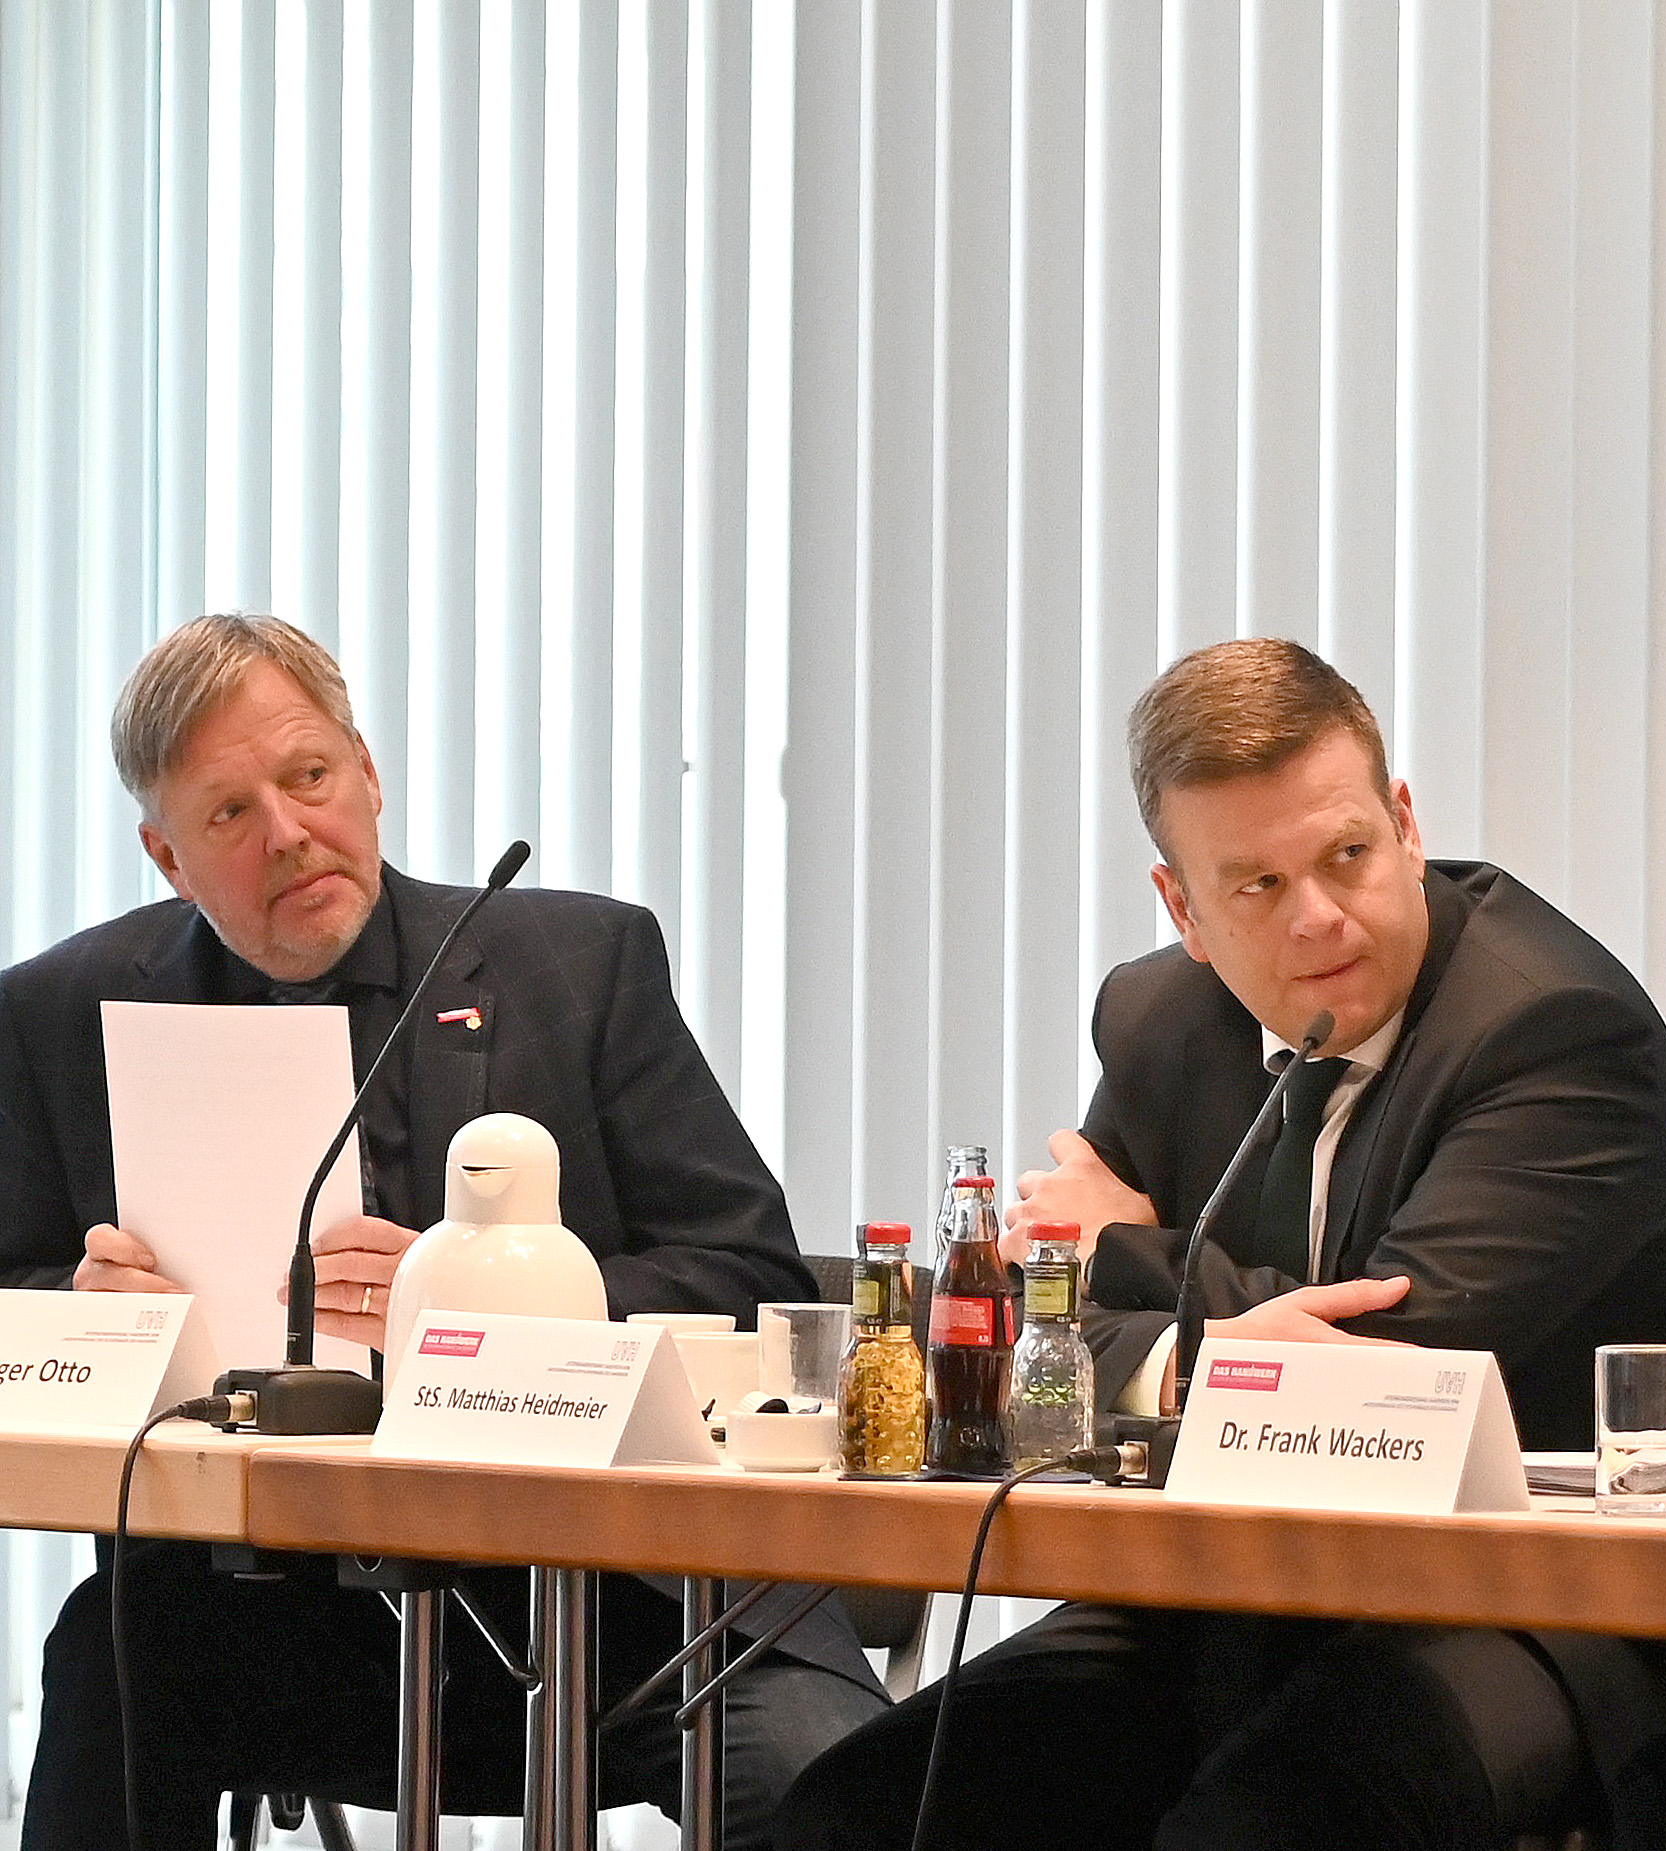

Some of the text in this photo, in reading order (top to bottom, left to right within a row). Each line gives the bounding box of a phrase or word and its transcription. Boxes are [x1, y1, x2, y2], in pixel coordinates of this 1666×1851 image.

[39, 1358, 92, 1383] Otto
[413, 1385, 609, 1420] StS. Matthias Heidmeier
[1218, 1421, 1425, 1462] Dr. Frank Wackers
